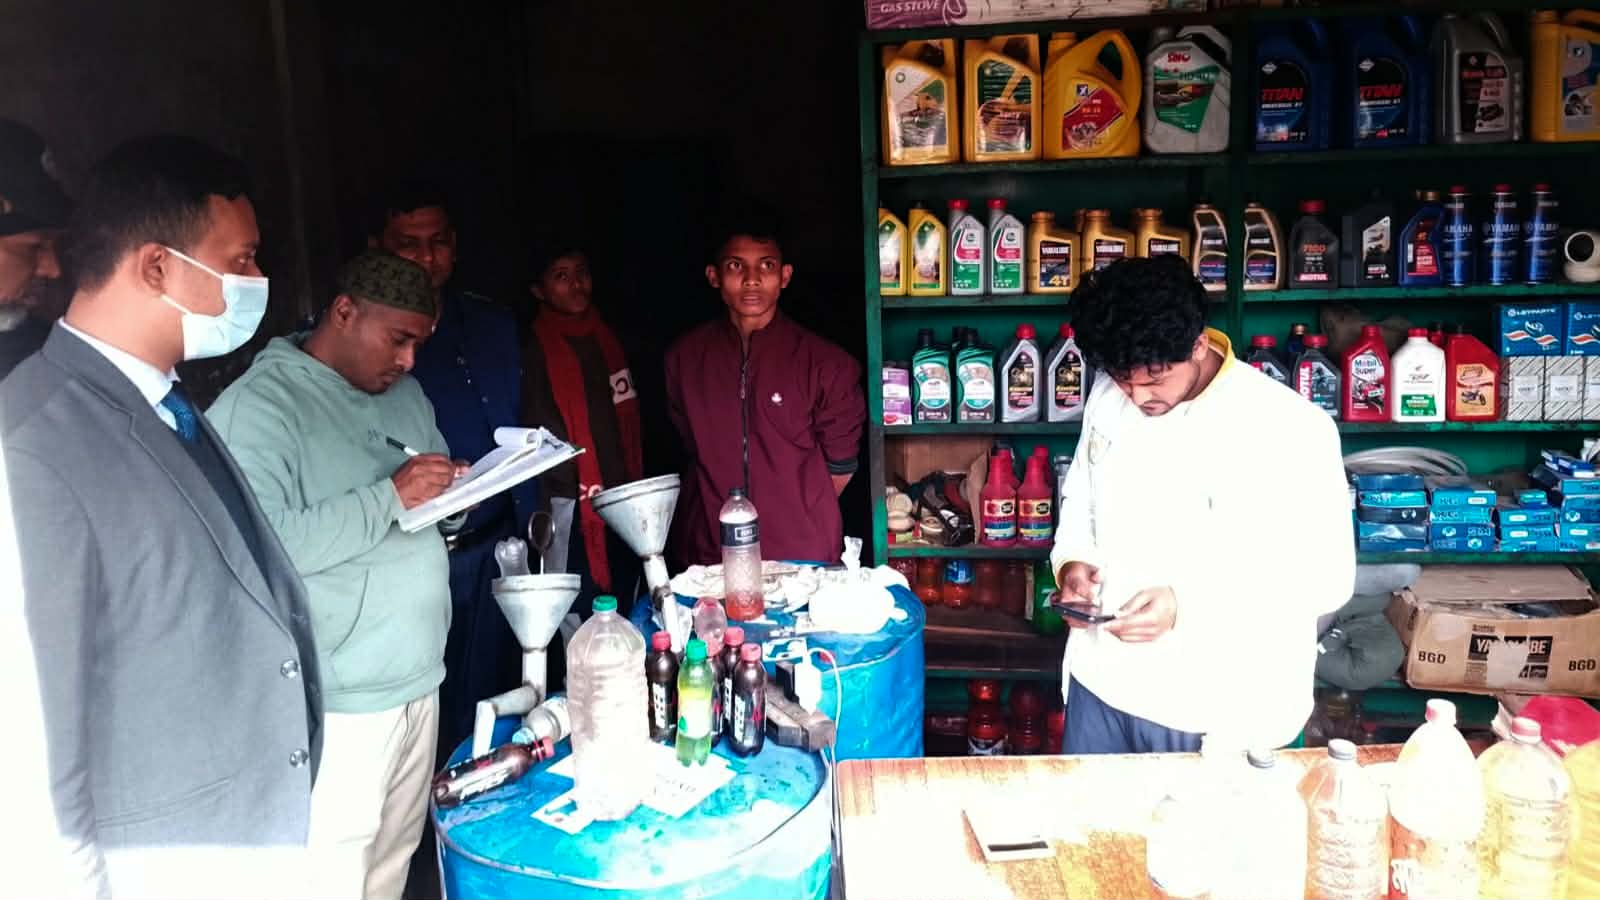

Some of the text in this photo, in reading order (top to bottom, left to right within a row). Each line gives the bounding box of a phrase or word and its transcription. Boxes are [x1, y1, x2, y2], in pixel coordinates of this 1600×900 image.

[881, 0, 939, 13] GAS STOVE
[1262, 88, 1304, 101] TITAN
[1359, 84, 1403, 100] TITAN
[1049, 275, 1070, 287] 4T
[1355, 359, 1377, 368] Mobil
[1355, 367, 1377, 376] Super
[1418, 651, 1447, 665] BGD
[1568, 659, 1597, 672] BGD
